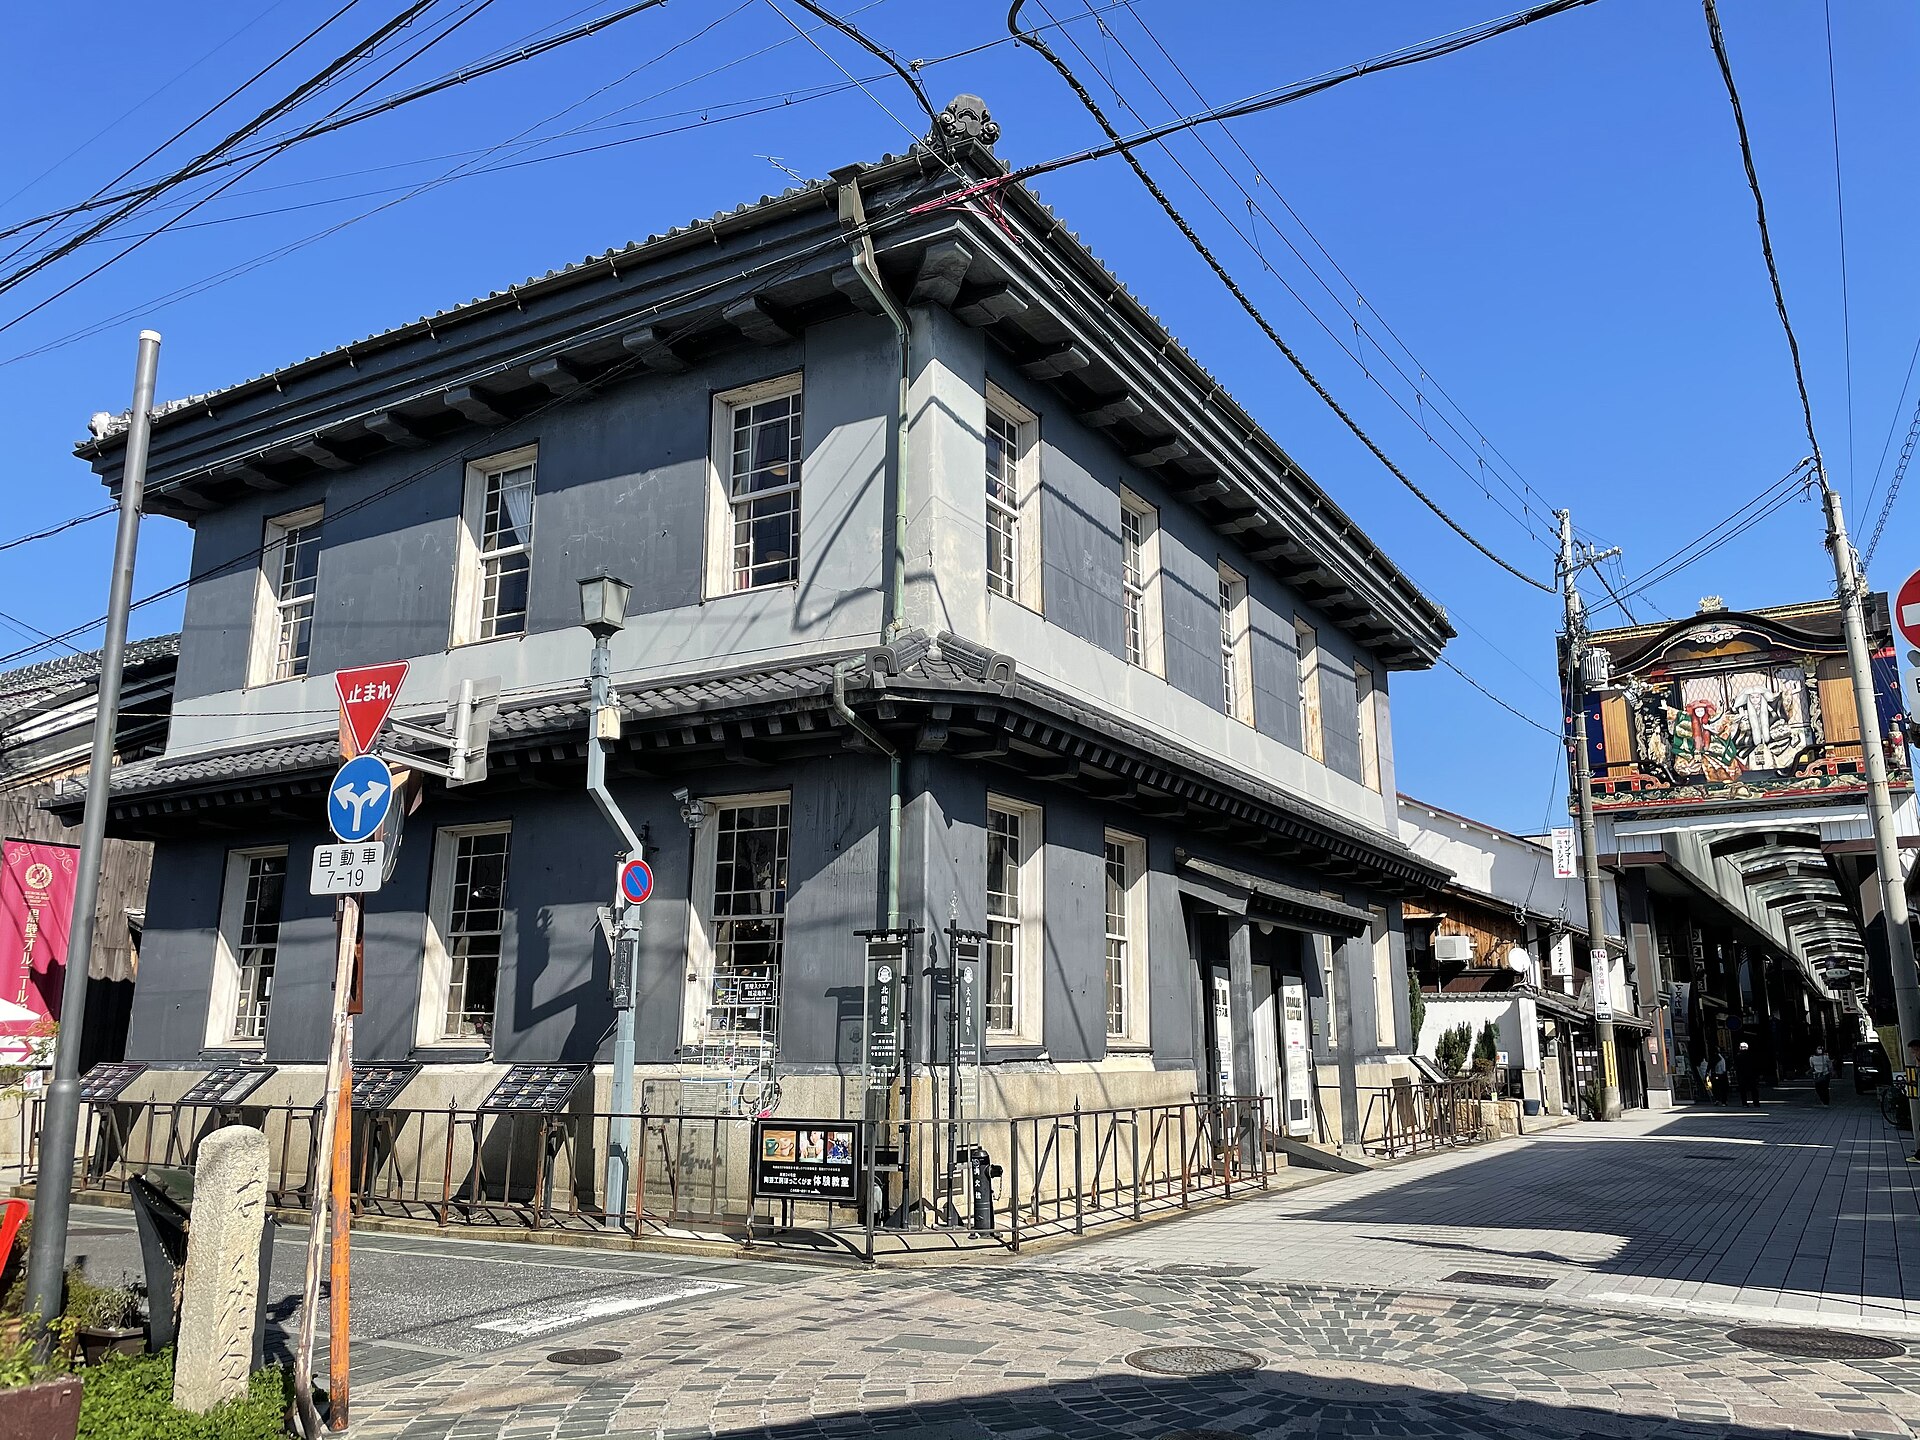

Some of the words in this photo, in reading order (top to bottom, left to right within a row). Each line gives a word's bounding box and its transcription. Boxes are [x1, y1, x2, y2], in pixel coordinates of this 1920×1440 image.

[347, 681, 392, 703] 止まれ
[320, 848, 376, 868] 自動車
[327, 869, 364, 888] 7-19
[16, 908, 40, 1009] 黒壁オルゴール
[880, 986, 888, 1026] 北国街道
[813, 1175, 849, 1187] 体験教室
